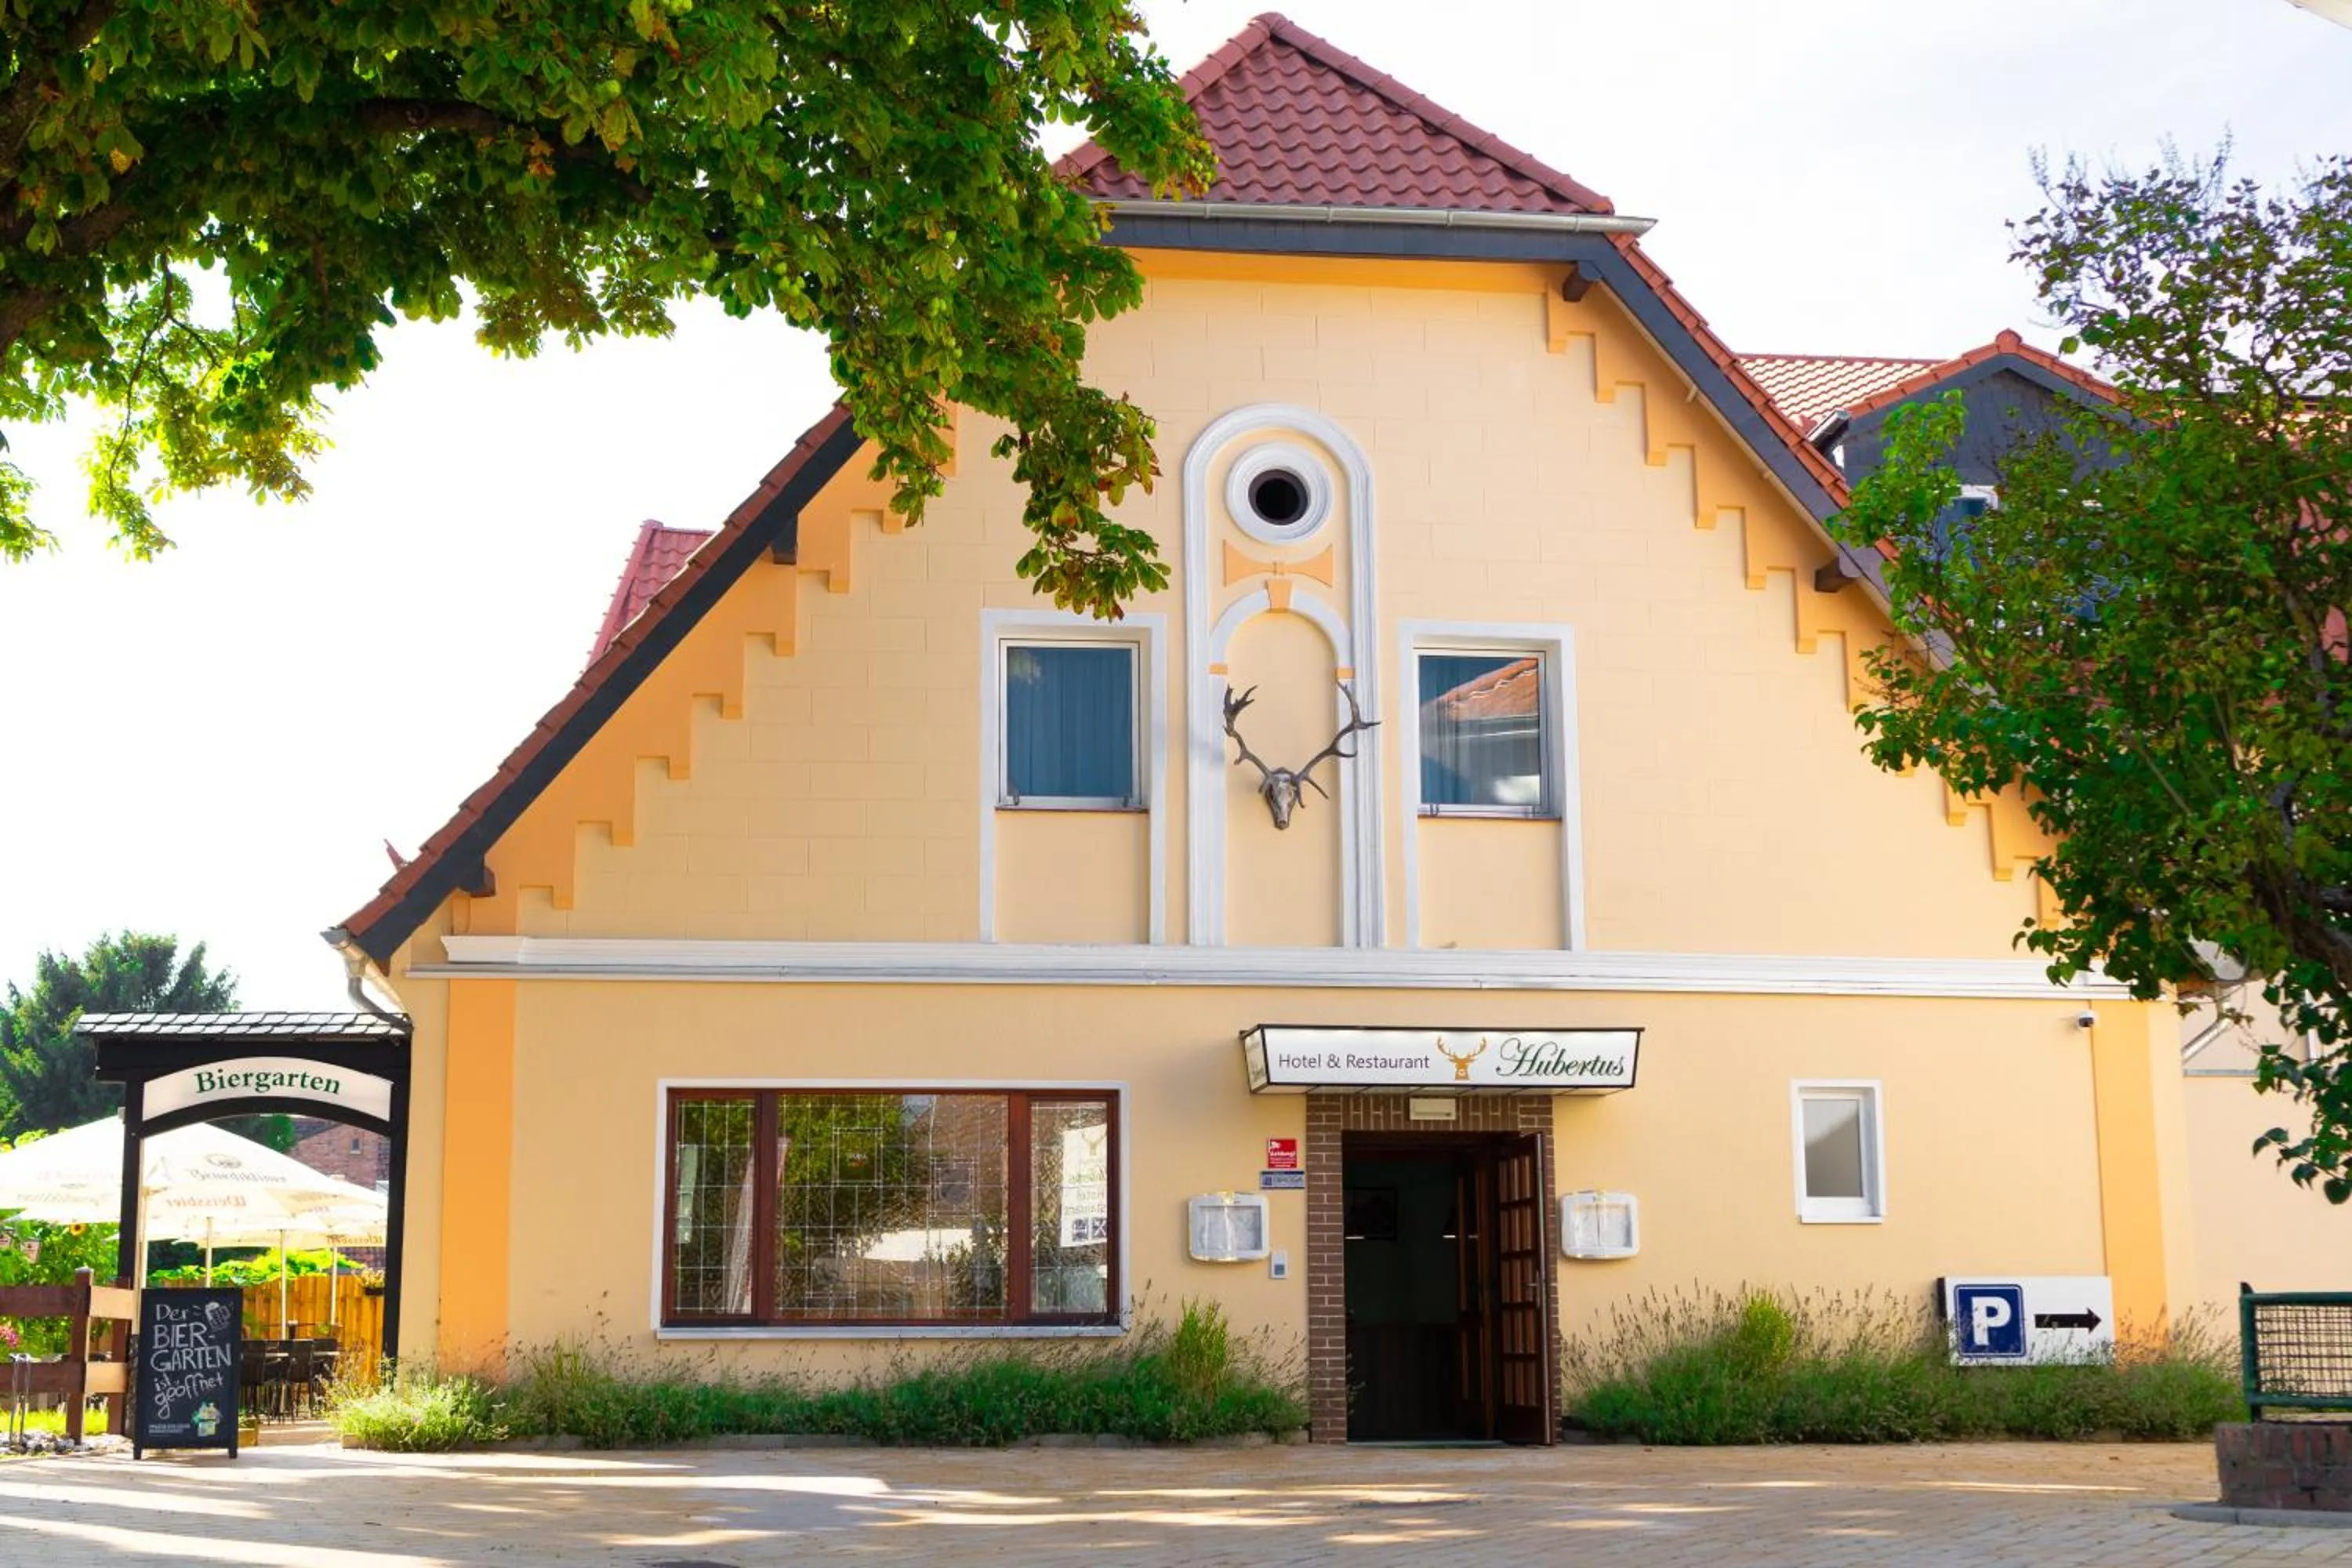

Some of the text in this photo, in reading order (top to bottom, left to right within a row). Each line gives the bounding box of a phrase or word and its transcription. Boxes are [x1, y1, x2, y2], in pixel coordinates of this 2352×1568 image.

[1279, 1037, 1625, 1077] Hotel & Restaurant Hubertus
[194, 1069, 340, 1094] Biergarten
[155, 1304, 190, 1321] Der
[1971, 1296, 2012, 1345] P
[152, 1321, 216, 1349] BIER-
[150, 1343, 232, 1372] GARTEN
[154, 1373, 171, 1392] ist
[154, 1372, 223, 1420] geöffnet
